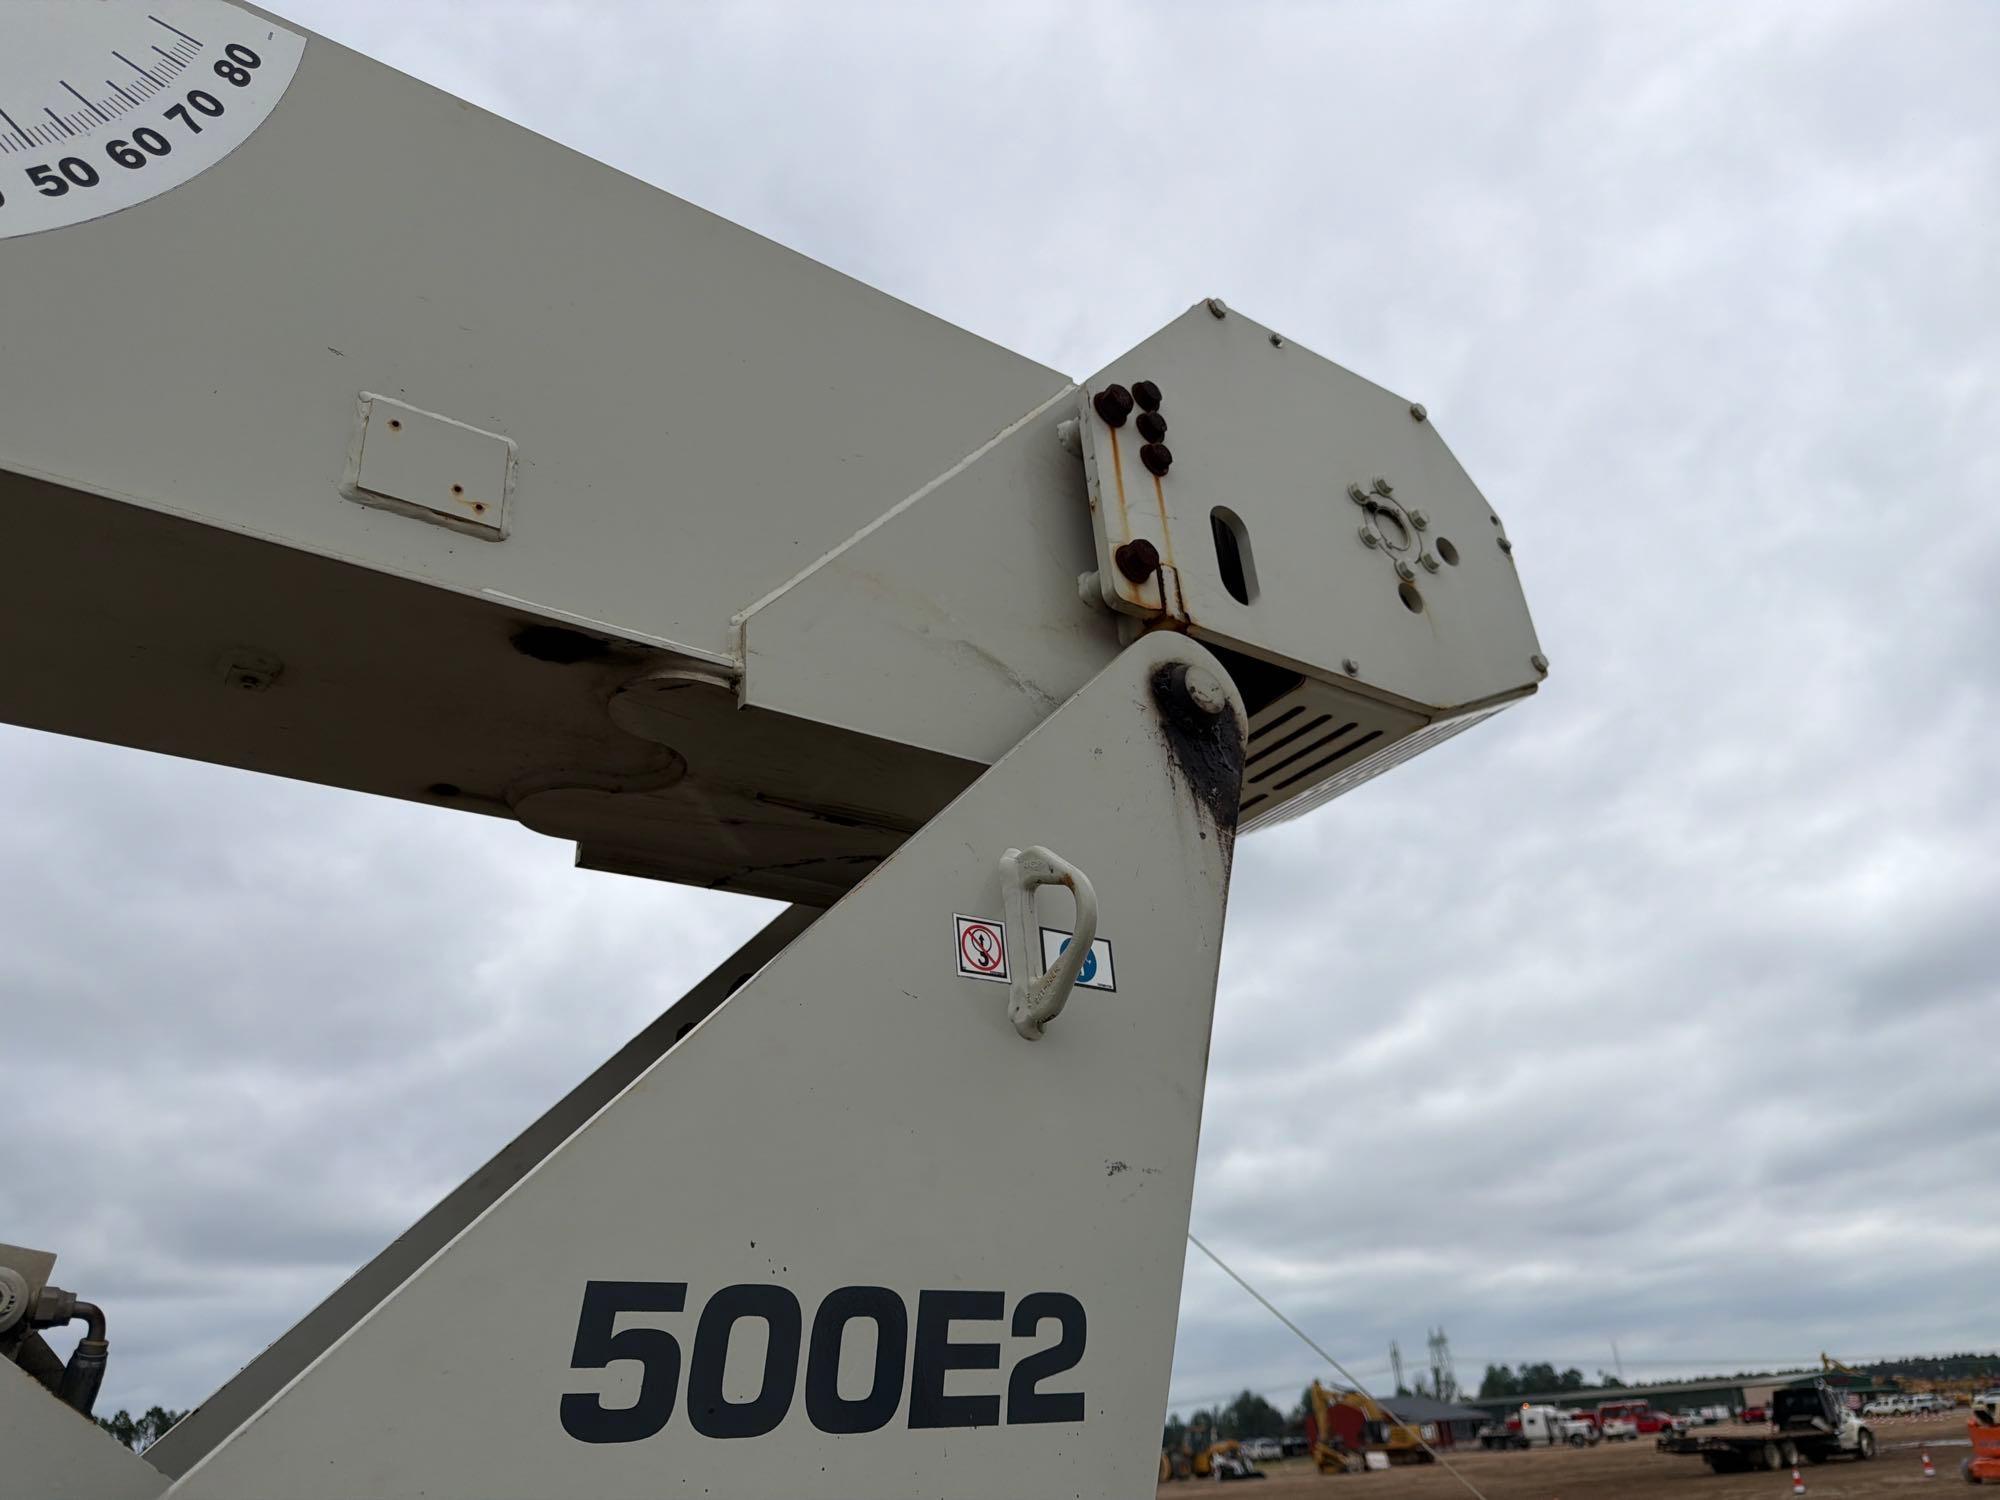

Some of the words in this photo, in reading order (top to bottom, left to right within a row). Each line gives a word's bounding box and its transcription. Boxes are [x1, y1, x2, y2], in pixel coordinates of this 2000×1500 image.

[25, 157, 100, 197] 50
[105, 127, 172, 170] 60
[163, 90, 225, 134] 70
[213, 43, 262, 88] 80
[560, 1280, 1087, 1443] 500E2
